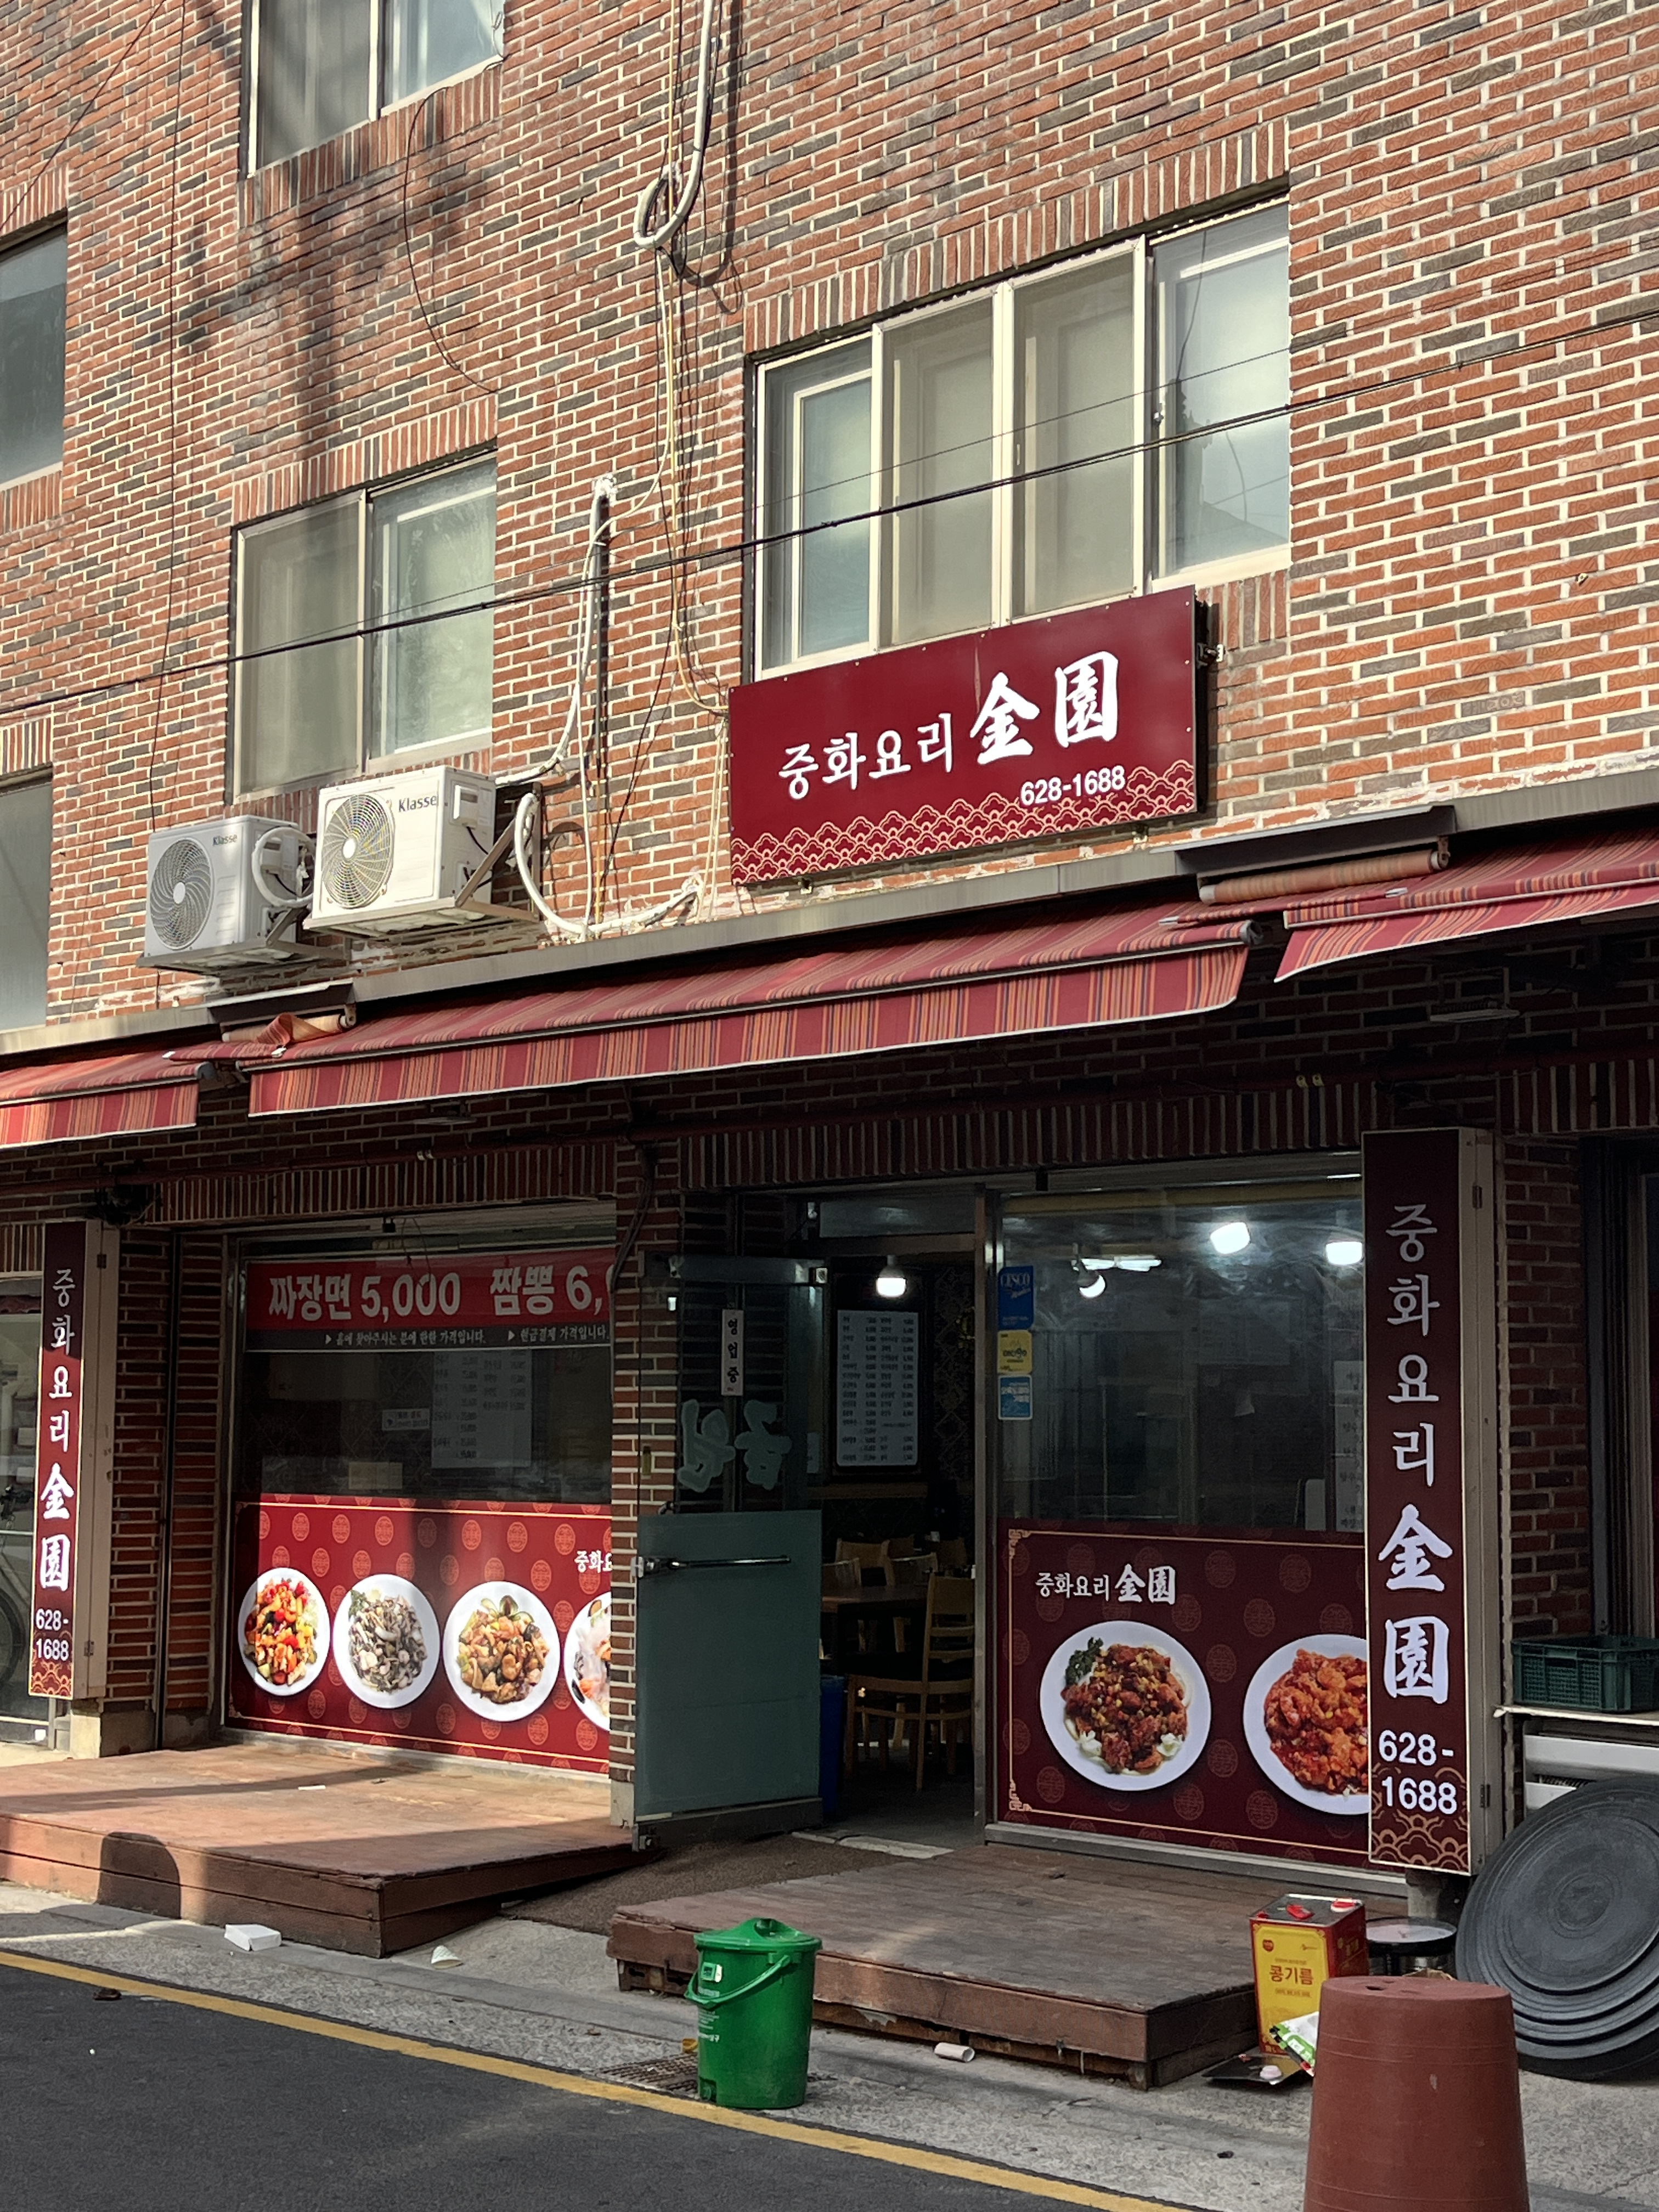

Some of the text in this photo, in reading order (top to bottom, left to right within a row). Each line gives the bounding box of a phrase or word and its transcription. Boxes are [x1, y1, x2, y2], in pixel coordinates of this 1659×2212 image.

[778, 651, 1119, 800] 중화요리 金園
[398, 795, 437, 812] Klasse
[1020, 765, 1126, 806] 628-1688
[212, 834, 238, 849] Klasse
[269, 1263, 615, 1323] 짜장면 5,000 짬뽕 6,
[559, 1324, 610, 1341] 가격입니다.
[727, 1318, 740, 1384] 영업중
[40, 1268, 75, 1592] 중화요리 金園
[1378, 1204, 1453, 1705] 중화요리 金園
[1035, 1564, 1176, 1605] 중화요리 金園
[36, 1608, 69, 1632] 628-
[36, 1638, 69, 1661] 1688
[1379, 1729, 1454, 1766] 628-
[1381, 1773, 1458, 1815] 1688
[1269, 1964, 1313, 1985] 콩기름
